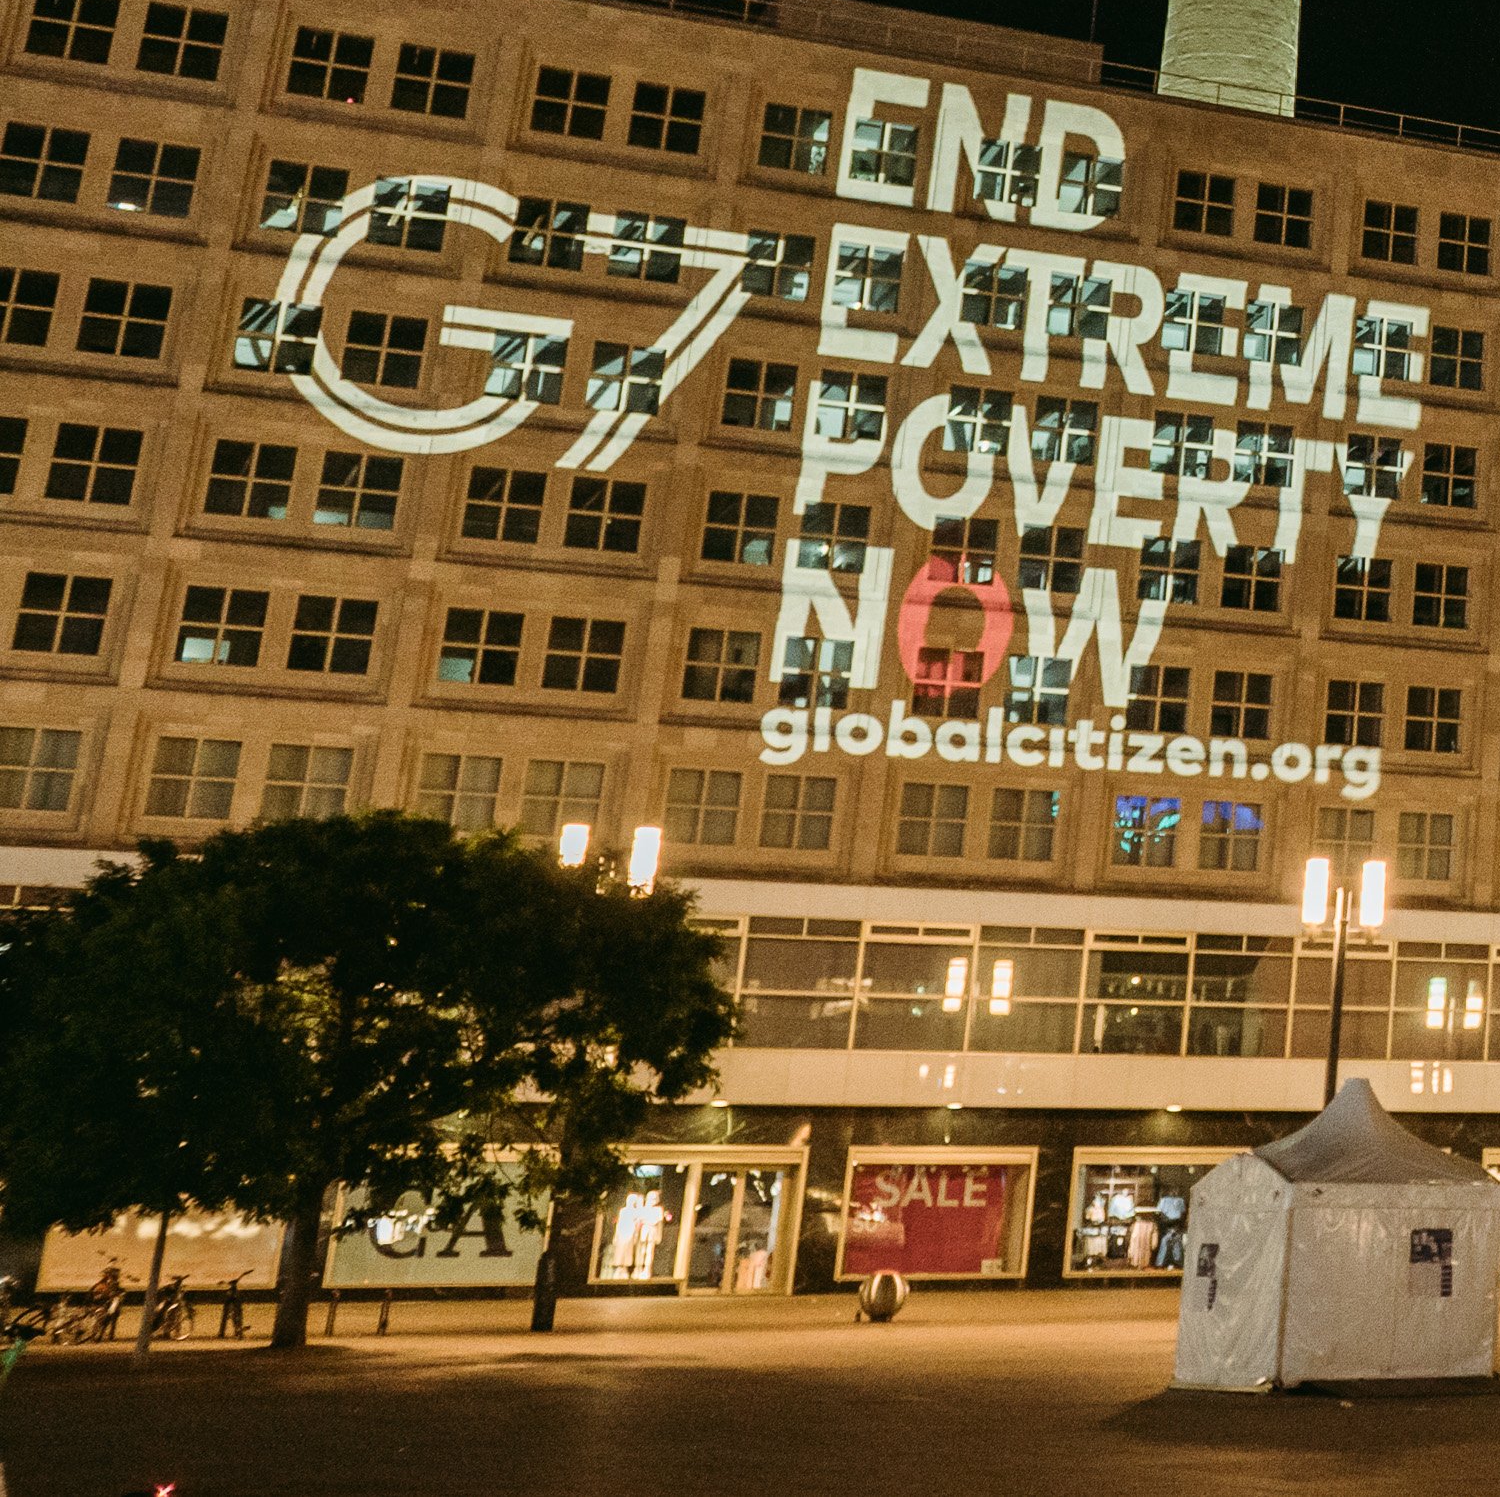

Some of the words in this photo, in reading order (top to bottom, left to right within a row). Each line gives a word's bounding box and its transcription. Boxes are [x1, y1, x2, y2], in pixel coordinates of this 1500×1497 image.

[836, 67, 1126, 231] END
[262, 174, 782, 471] G7
[818, 223, 1430, 429] EXTREME
[794, 379, 1416, 573] POVERTY
[770, 537, 1169, 708] NOW
[759, 698, 1381, 800] globalcitizen.org
[872, 1168, 988, 1208] SALE
